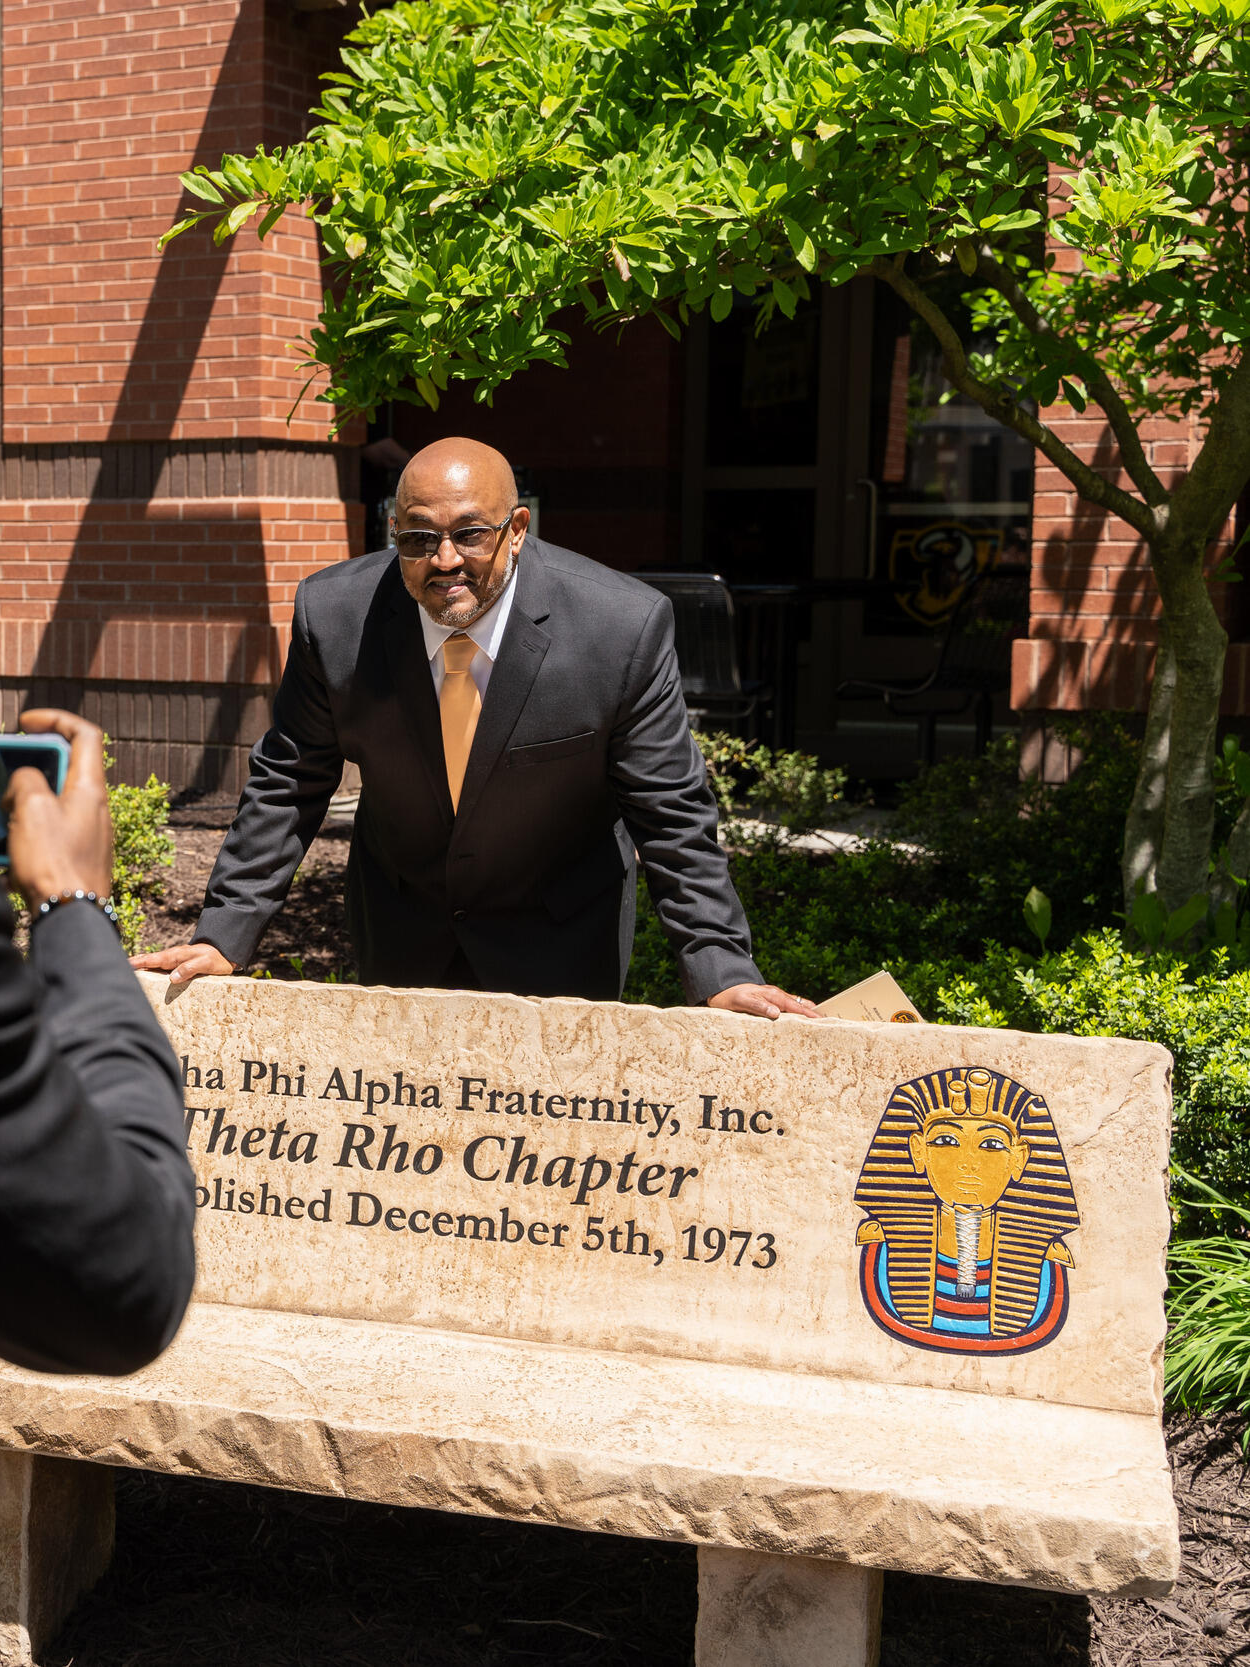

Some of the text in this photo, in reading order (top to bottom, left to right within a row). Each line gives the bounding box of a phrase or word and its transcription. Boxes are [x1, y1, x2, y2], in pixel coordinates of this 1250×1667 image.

[239, 1059, 307, 1098] Phi
[318, 1067, 443, 1117] Alpha
[456, 1076, 681, 1138] Fraternity,
[698, 1094, 786, 1137] Inc.
[184, 1106, 699, 1206] Theta Rho Chapter
[191, 1173, 778, 1269] blished December 5th, 1973
